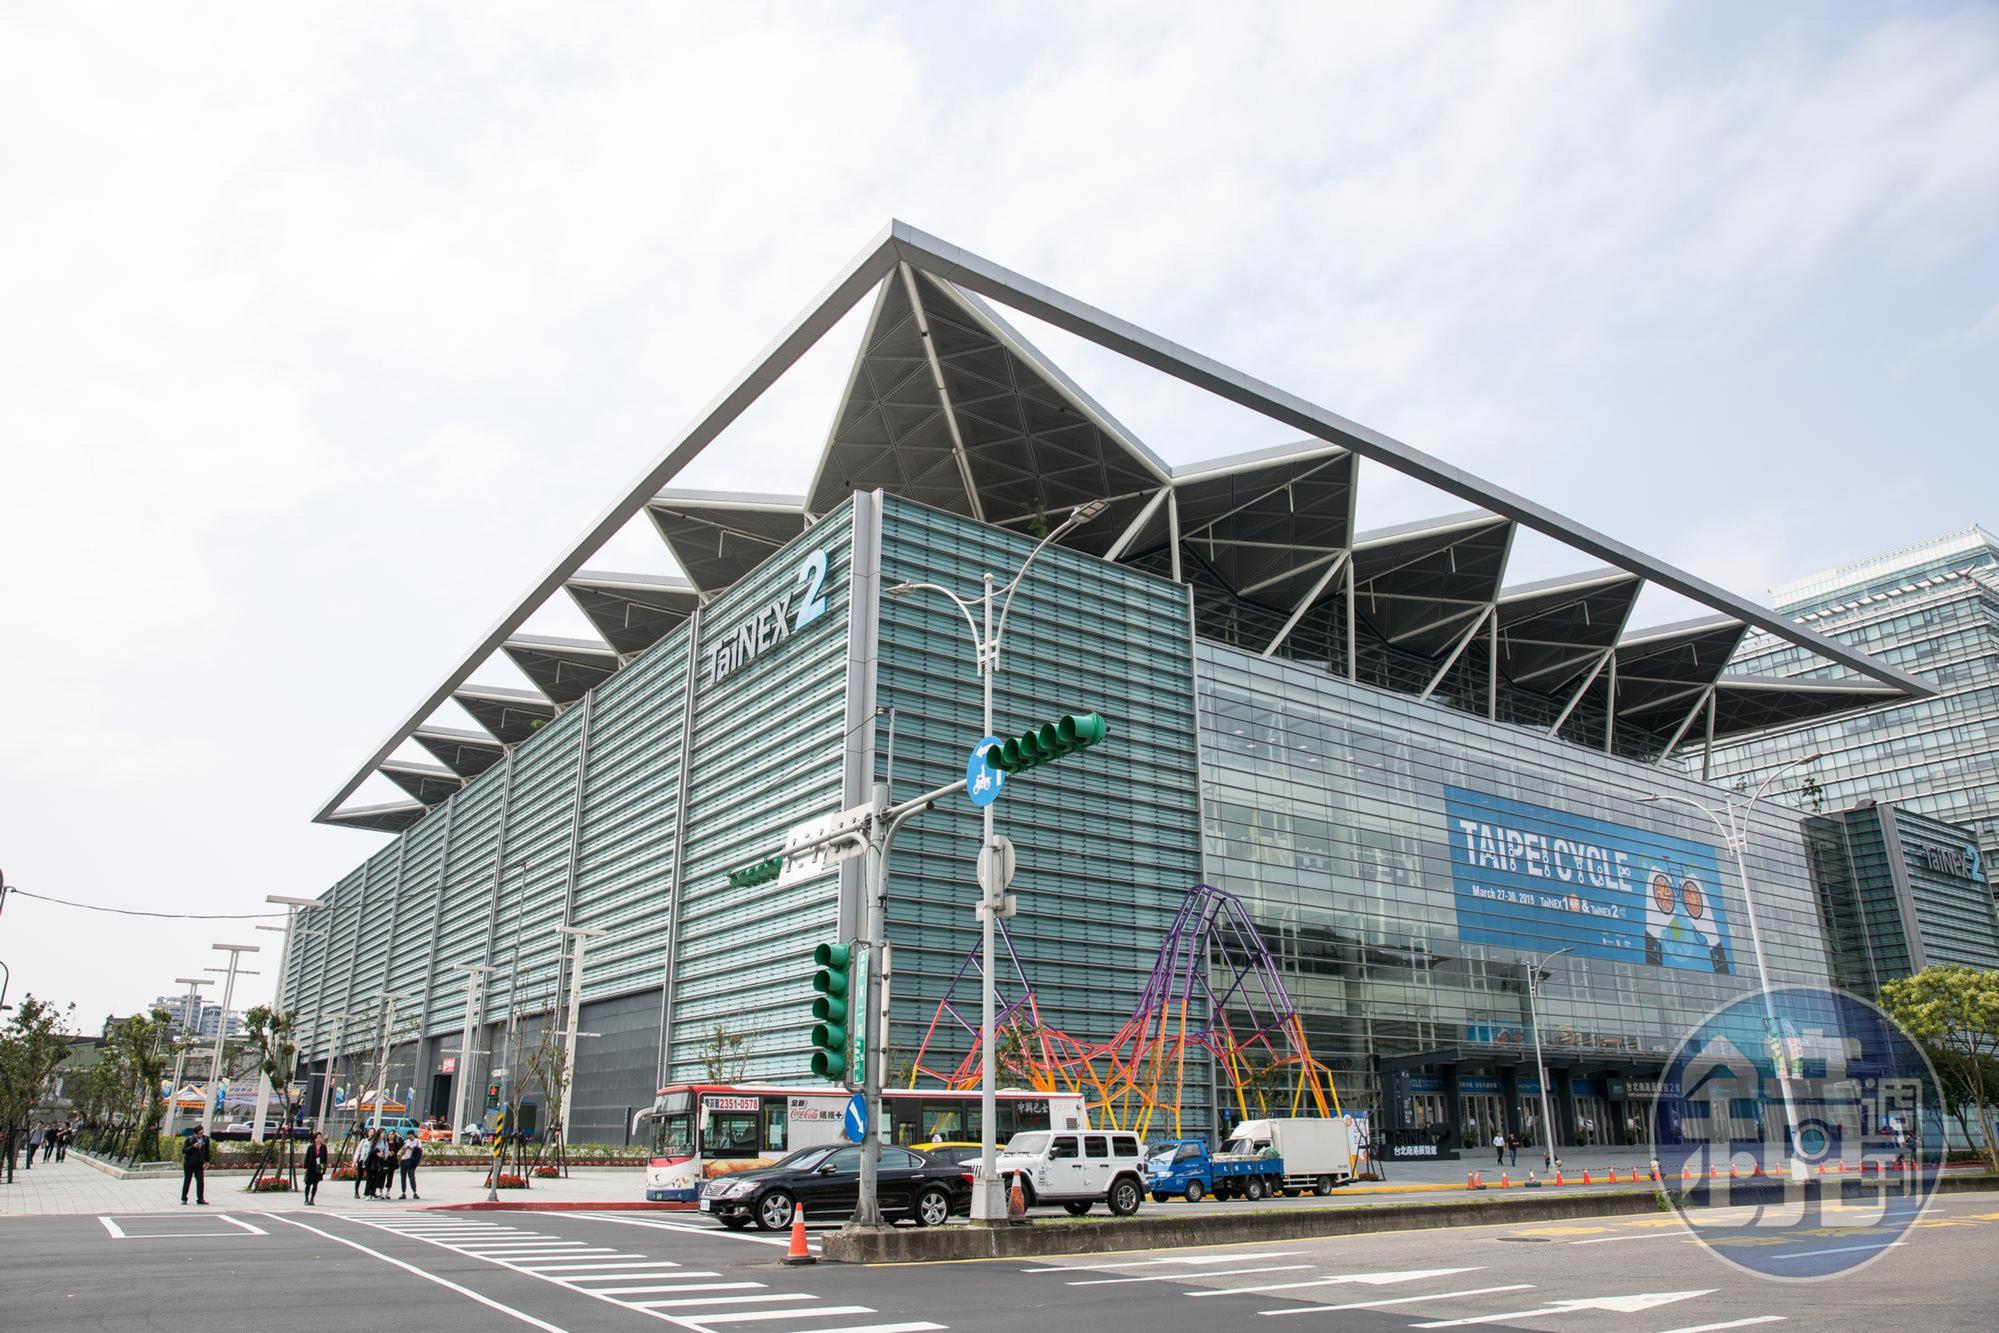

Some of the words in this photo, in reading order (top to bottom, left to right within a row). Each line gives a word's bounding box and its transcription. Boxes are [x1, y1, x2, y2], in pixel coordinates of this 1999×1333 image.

[709, 592, 793, 685] TaiNEX
[795, 549, 829, 632] 2
[1460, 820, 1551, 878] TAIPEI
[1553, 838, 1632, 892] CYCLE
[1921, 846, 1970, 879] TaiNEX
[1964, 844, 1986, 883] 2
[1472, 885, 1496, 899] March
[1582, 900, 1590, 913] &
[719, 1098, 758, 1109] 2351-0578
[1016, 1101, 1048, 1113] 中興巴士
